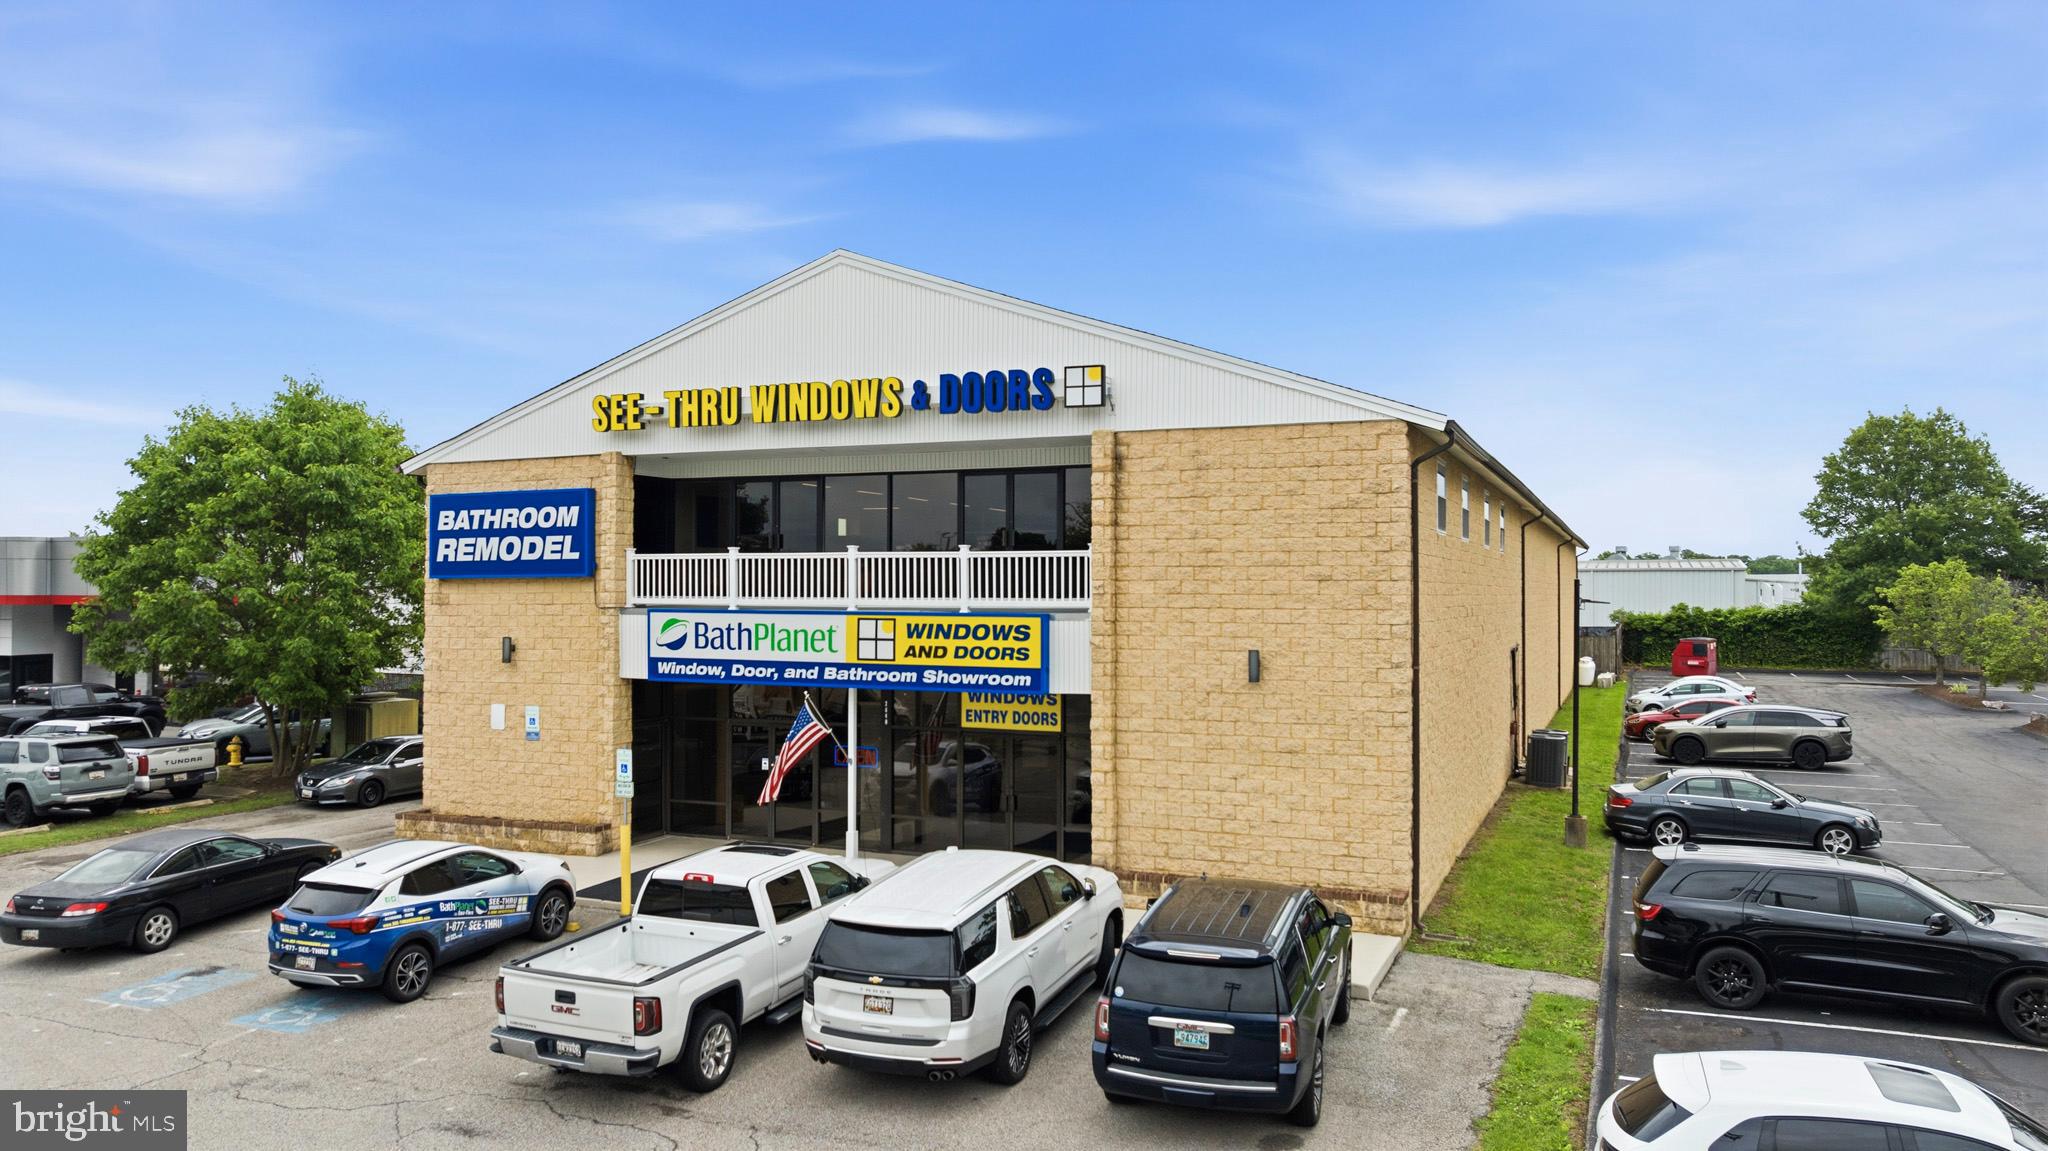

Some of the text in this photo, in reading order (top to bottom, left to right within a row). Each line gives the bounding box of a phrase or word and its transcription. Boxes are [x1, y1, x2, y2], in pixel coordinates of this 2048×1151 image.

[750, 376, 903, 424] WINDOWS
[911, 380, 932, 411] &
[939, 367, 1055, 415] DOORS
[437, 505, 580, 531] BATHROOM
[436, 535, 581, 562] REMODEL
[694, 621, 839, 654] BathPlanet
[905, 623, 1031, 642] WINDOWS
[903, 645, 1030, 661] AND DOORS
[657, 661, 1032, 687] Window, Door, and Bathroom Showroom
[968, 692, 1057, 706] WINDOWS
[965, 709, 1058, 726] ENTRY DOORS
[165, 756, 203, 765] TUNDRA
[551, 1005, 581, 1016] GMC
